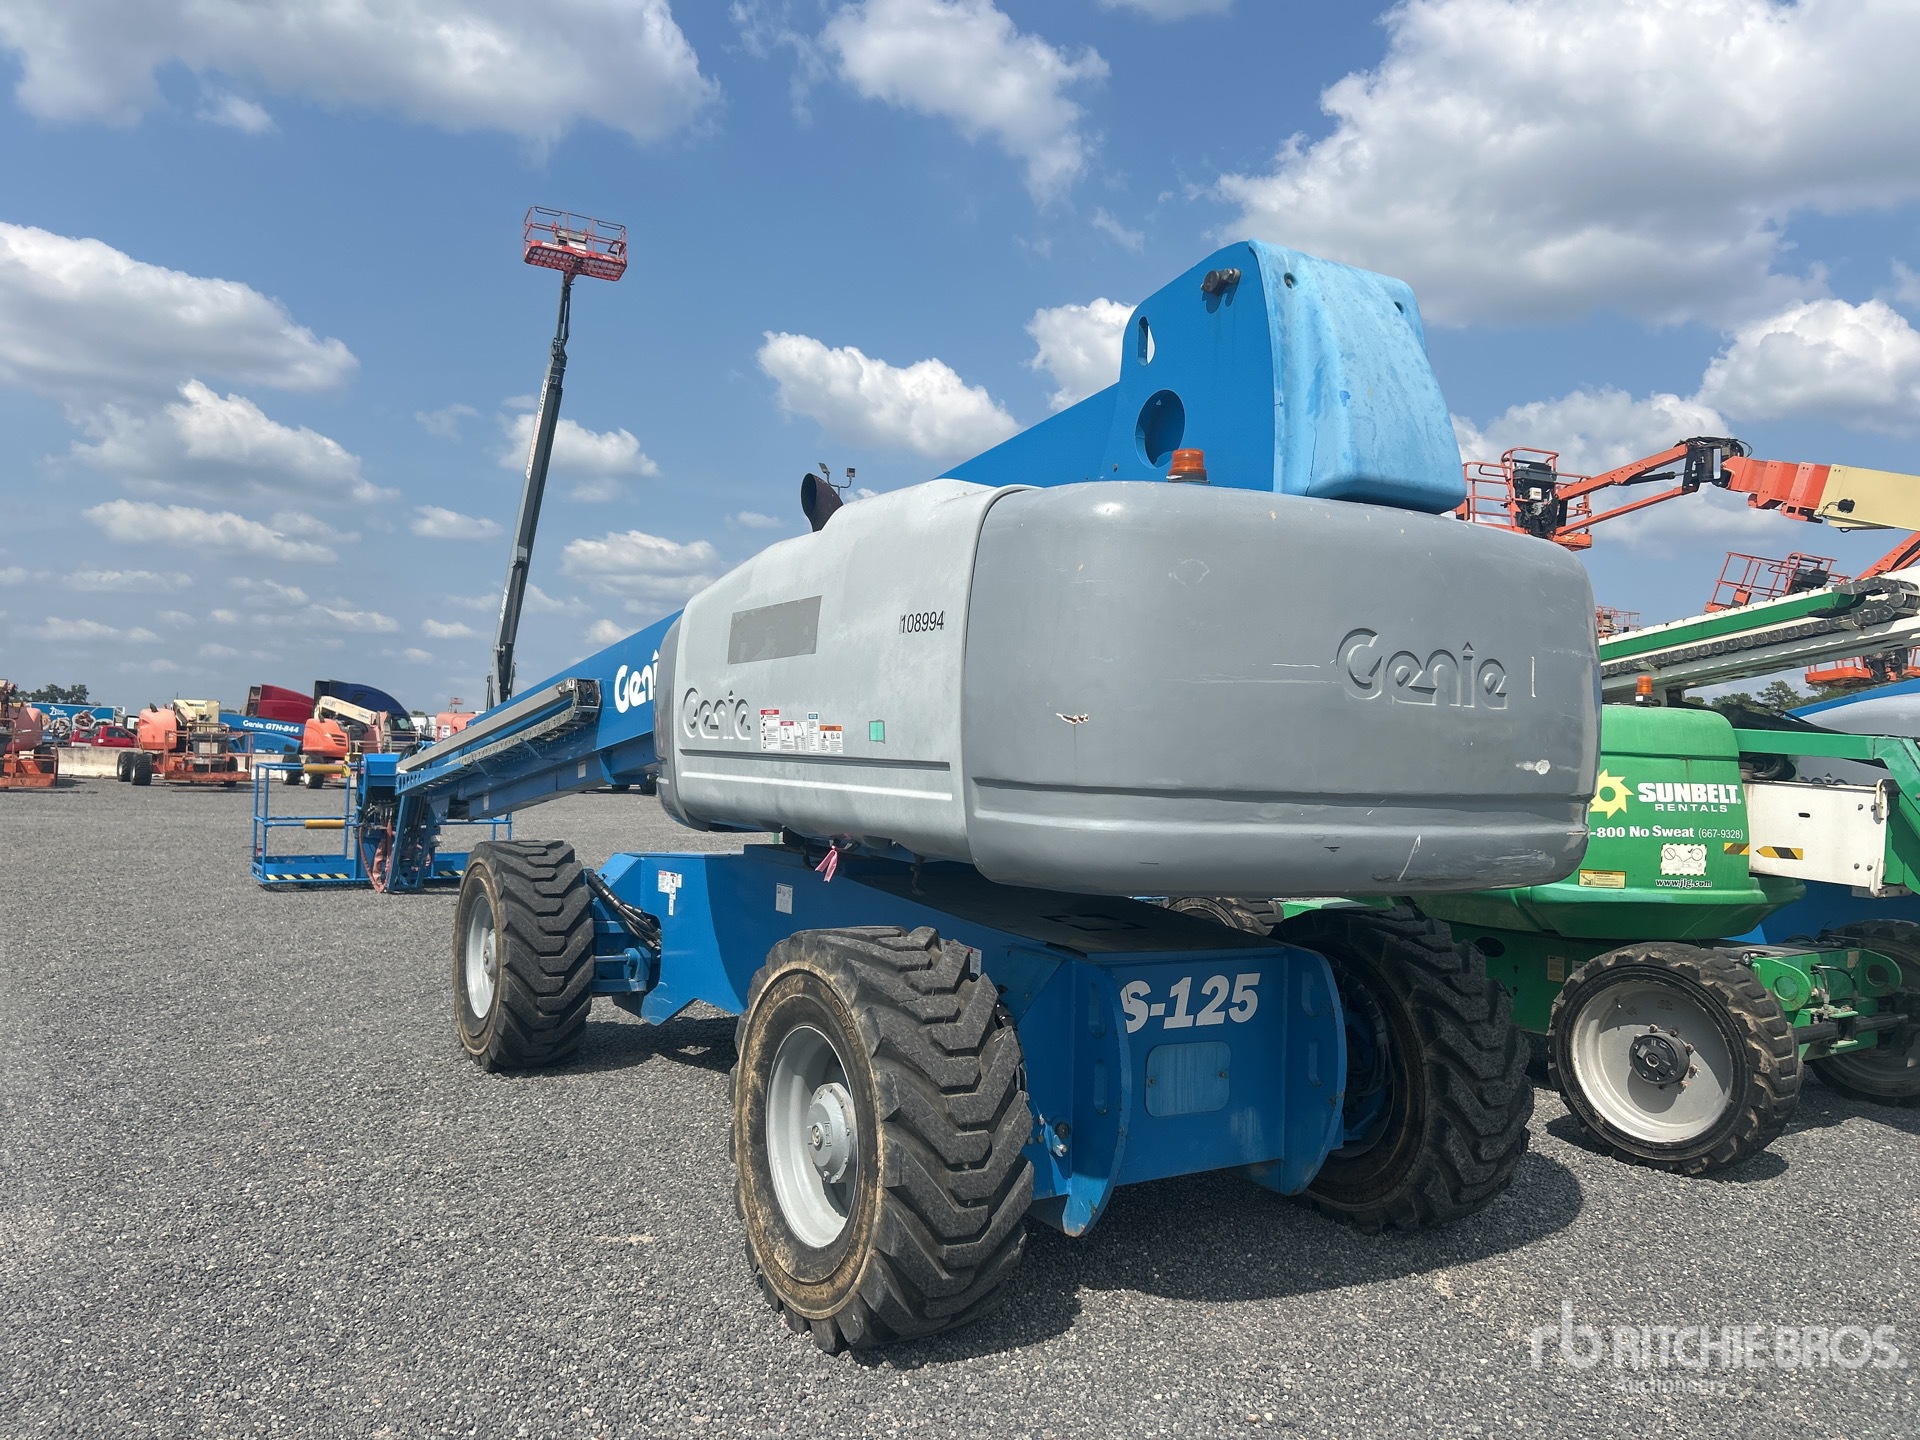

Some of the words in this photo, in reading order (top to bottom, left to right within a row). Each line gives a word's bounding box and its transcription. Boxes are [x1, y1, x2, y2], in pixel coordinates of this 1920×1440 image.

[900, 610, 944, 634] 108994
[1335, 627, 1508, 711] Genie
[614, 649, 660, 714] Geni
[682, 687, 752, 741] Genie
[265, 722, 300, 734] GTH-844
[1637, 782, 1739, 804] SUNBELT
[1654, 803, 1728, 813] RENTALS
[1590, 826, 1626, 838] -800
[1629, 825, 1650, 838] No
[1652, 824, 1695, 838] Sweat
[1697, 827, 1744, 840] (667-9328)
[1655, 878, 1712, 888] www.jlg.com
[1119, 971, 1261, 1034] S-125
